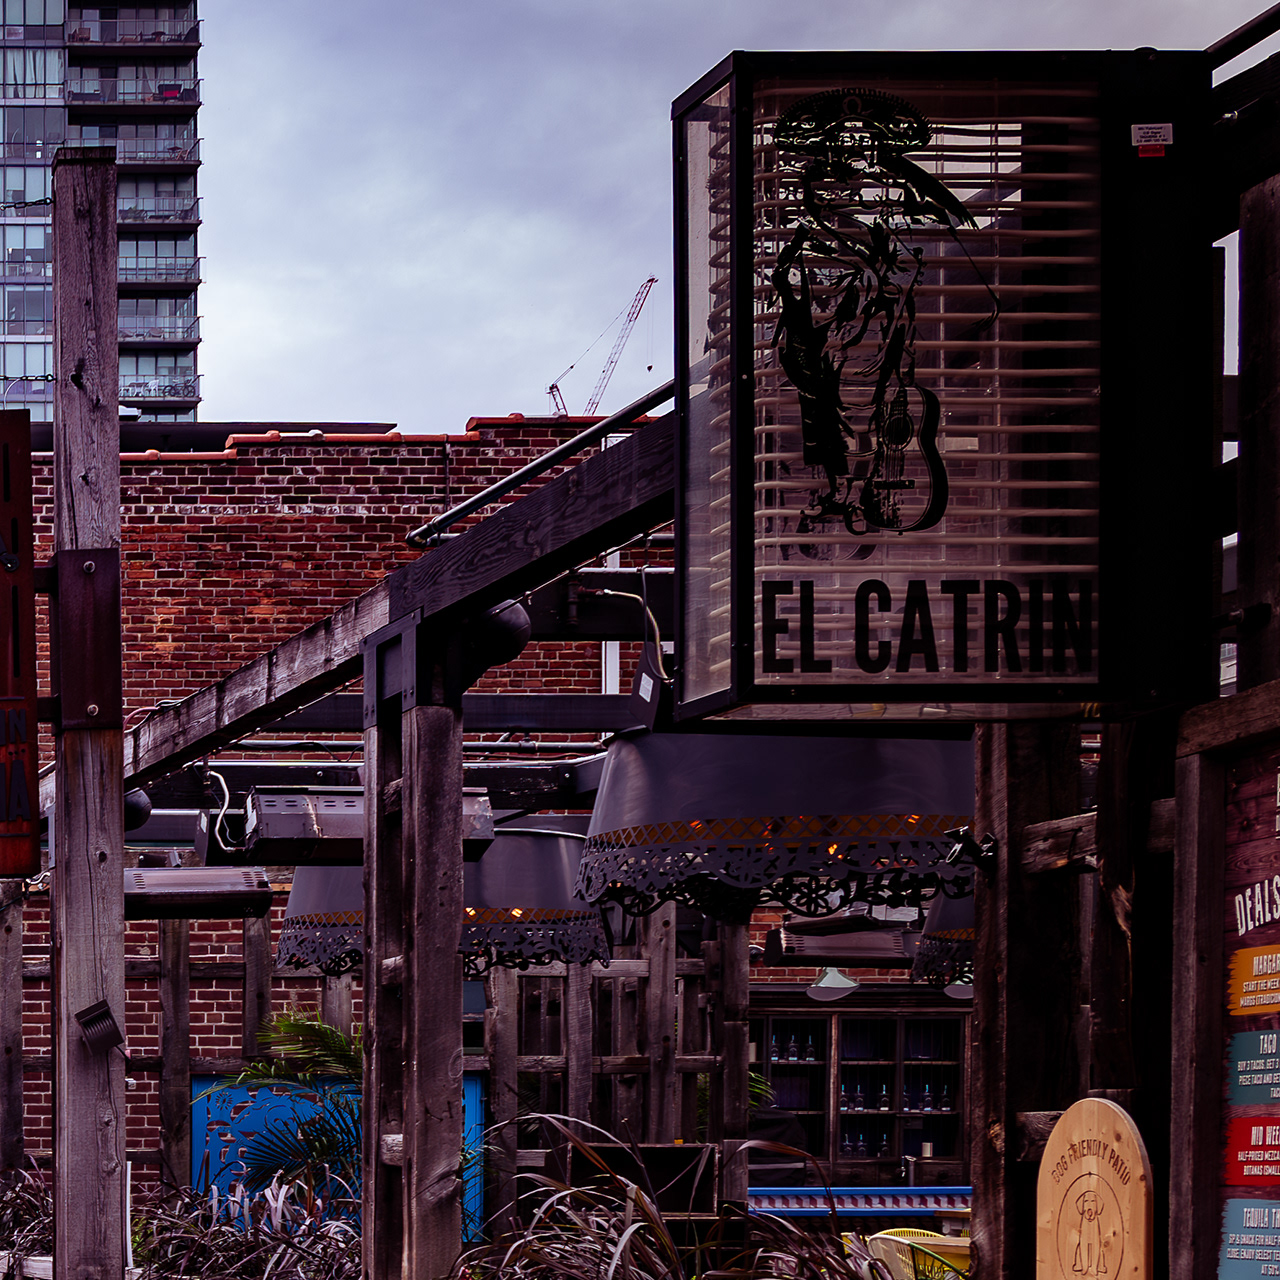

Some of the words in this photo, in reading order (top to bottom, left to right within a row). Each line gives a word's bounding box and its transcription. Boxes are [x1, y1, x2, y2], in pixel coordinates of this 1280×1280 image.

[761, 580, 832, 674] EL
[854, 579, 1093, 674] CATRIN
[1234, 874, 1280, 937] DEALS
[1259, 1033, 1277, 1055] TACO
[1051, 1155, 1069, 1184] DOG
[1067, 1139, 1109, 1165] FRIENDLY
[1108, 1148, 1131, 1186] PATIO
[1243, 1207, 1269, 1229] TEQUILA
